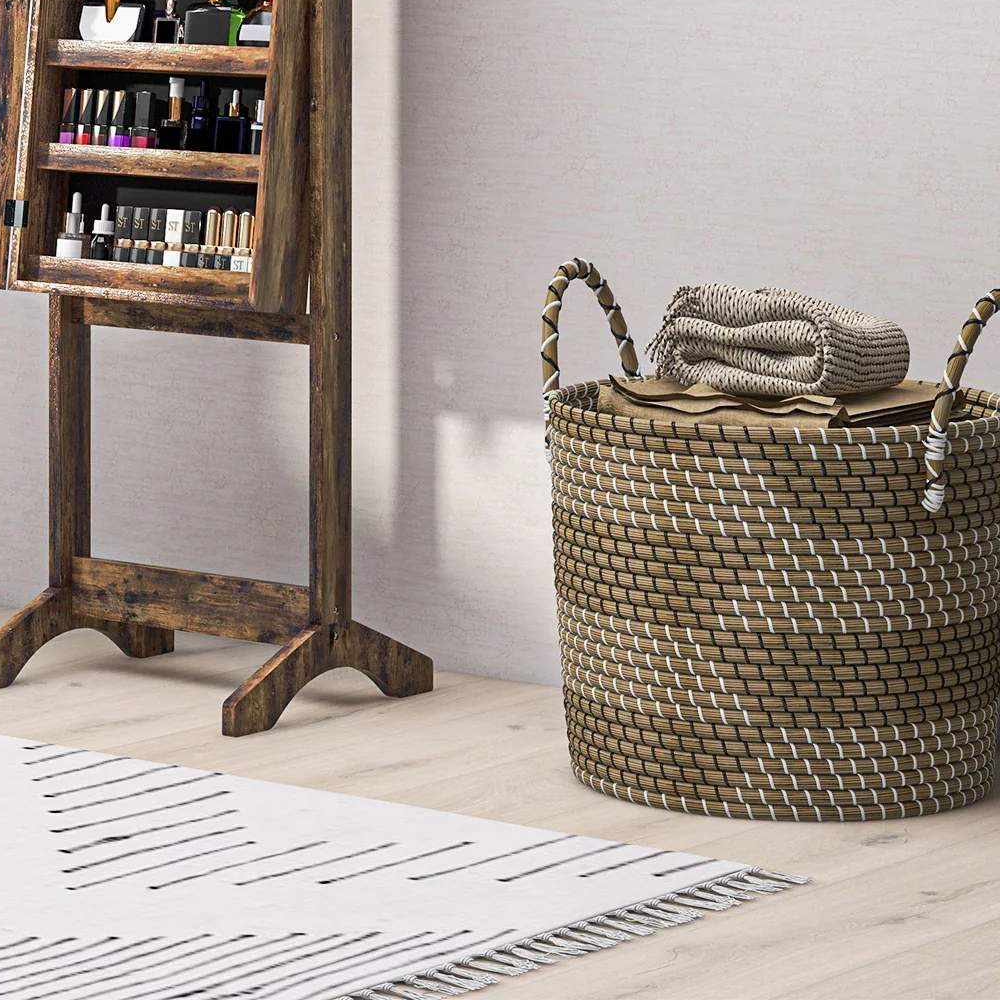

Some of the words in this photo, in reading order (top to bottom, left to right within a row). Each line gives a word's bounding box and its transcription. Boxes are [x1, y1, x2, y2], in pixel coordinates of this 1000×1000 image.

[117, 216, 128, 228] ST
[134, 218, 145, 229] ST
[151, 219, 161, 230] ST
[168, 221, 179, 231] ST
[185, 222, 195, 233] ST
[233, 260, 244, 270] ST
